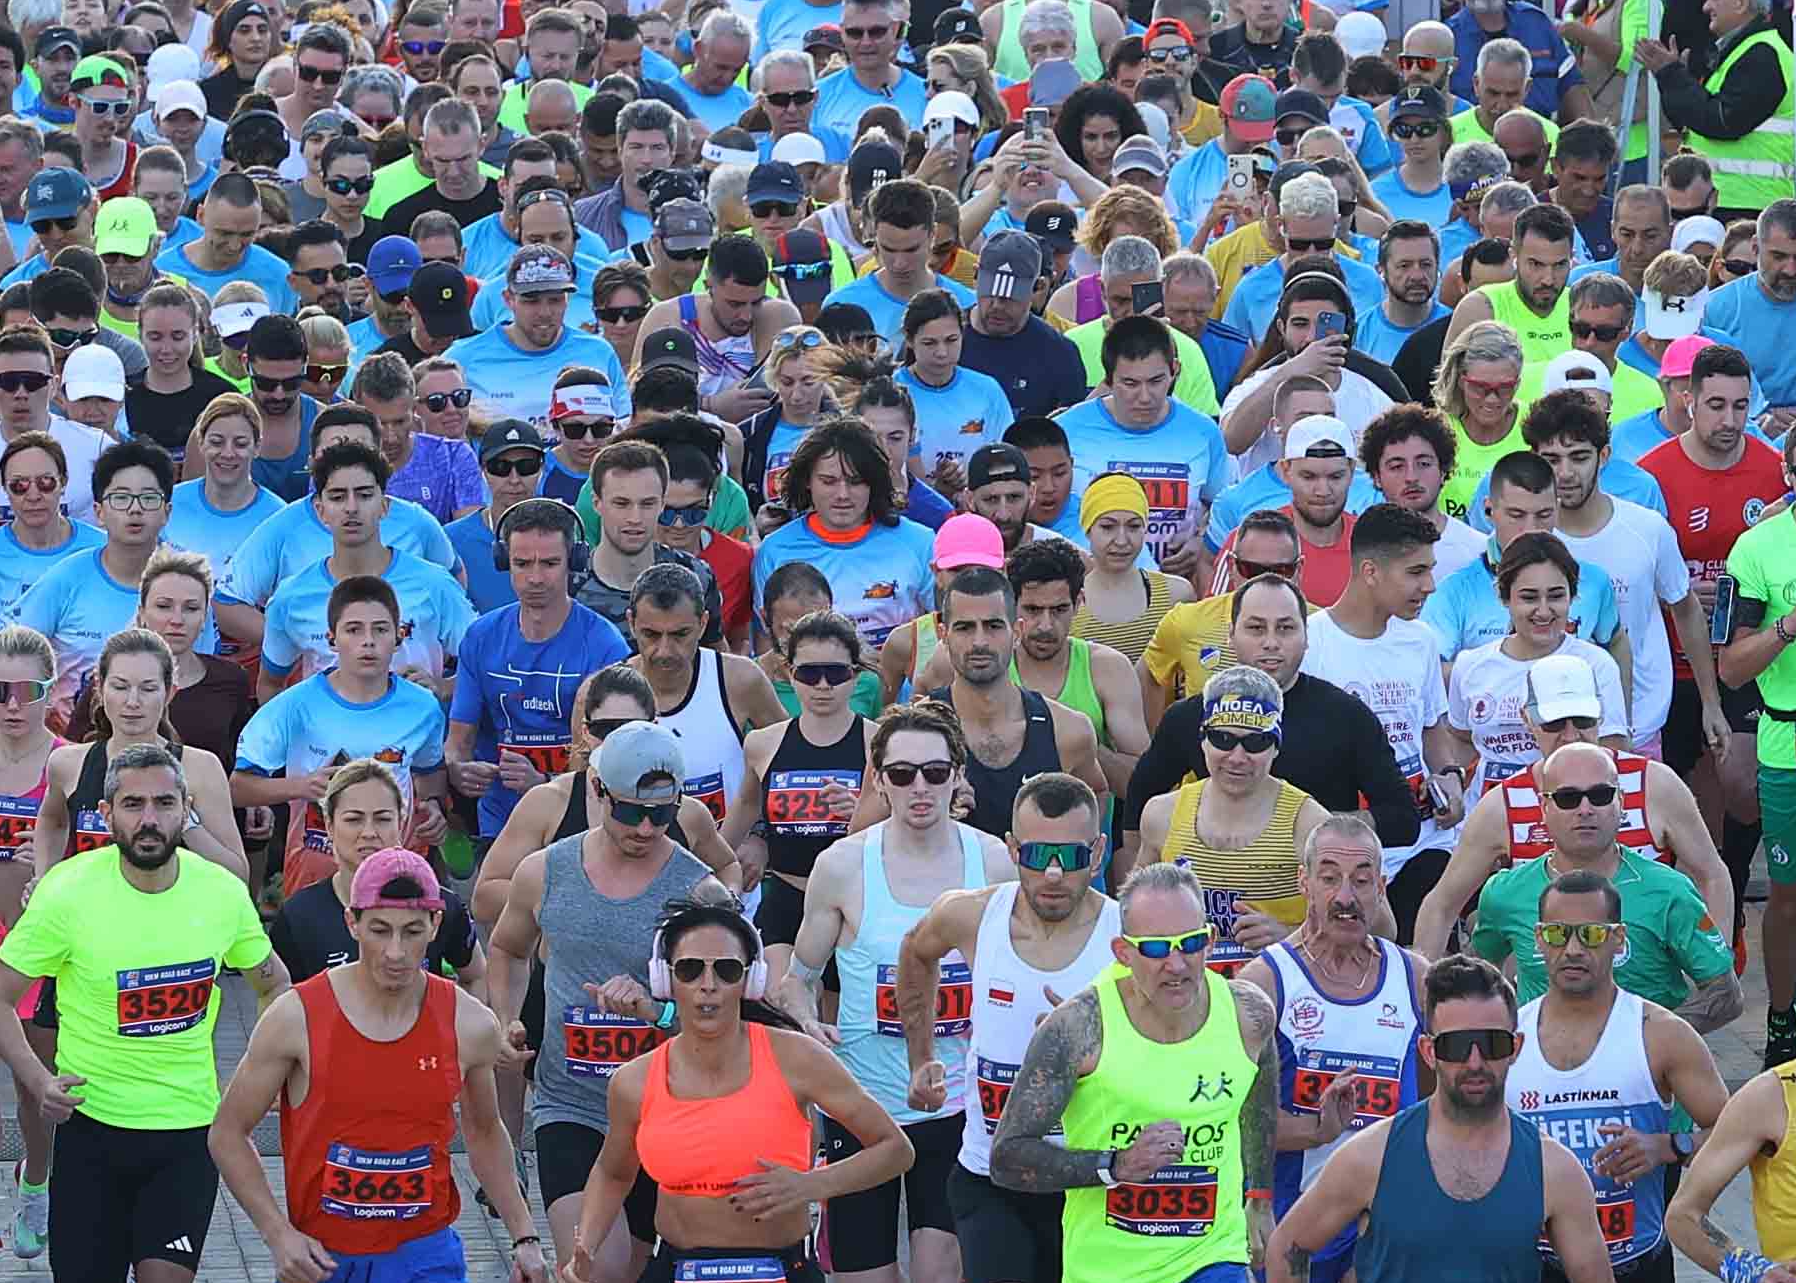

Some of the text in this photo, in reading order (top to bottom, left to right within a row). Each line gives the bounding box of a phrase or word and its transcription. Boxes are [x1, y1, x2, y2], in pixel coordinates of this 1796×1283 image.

[795, 824, 827, 835] Logicom
[124, 985, 210, 1020] 3520
[149, 1020, 188, 1034] Logicom
[573, 1029, 657, 1060] 3504
[1544, 1089, 1620, 1105] LASTİKMAR
[373, 1156, 389, 1166] ROAD
[389, 1156, 408, 1166] RACE
[1190, 1146, 1224, 1165] CLUB
[332, 1169, 427, 1200] 3663
[1113, 1185, 1211, 1218] 3035
[353, 1205, 396, 1219] Logicom
[1138, 1222, 1180, 1236] Logicom
[719, 1265, 736, 1275] ROAD
[737, 1264, 755, 1274] RACE
